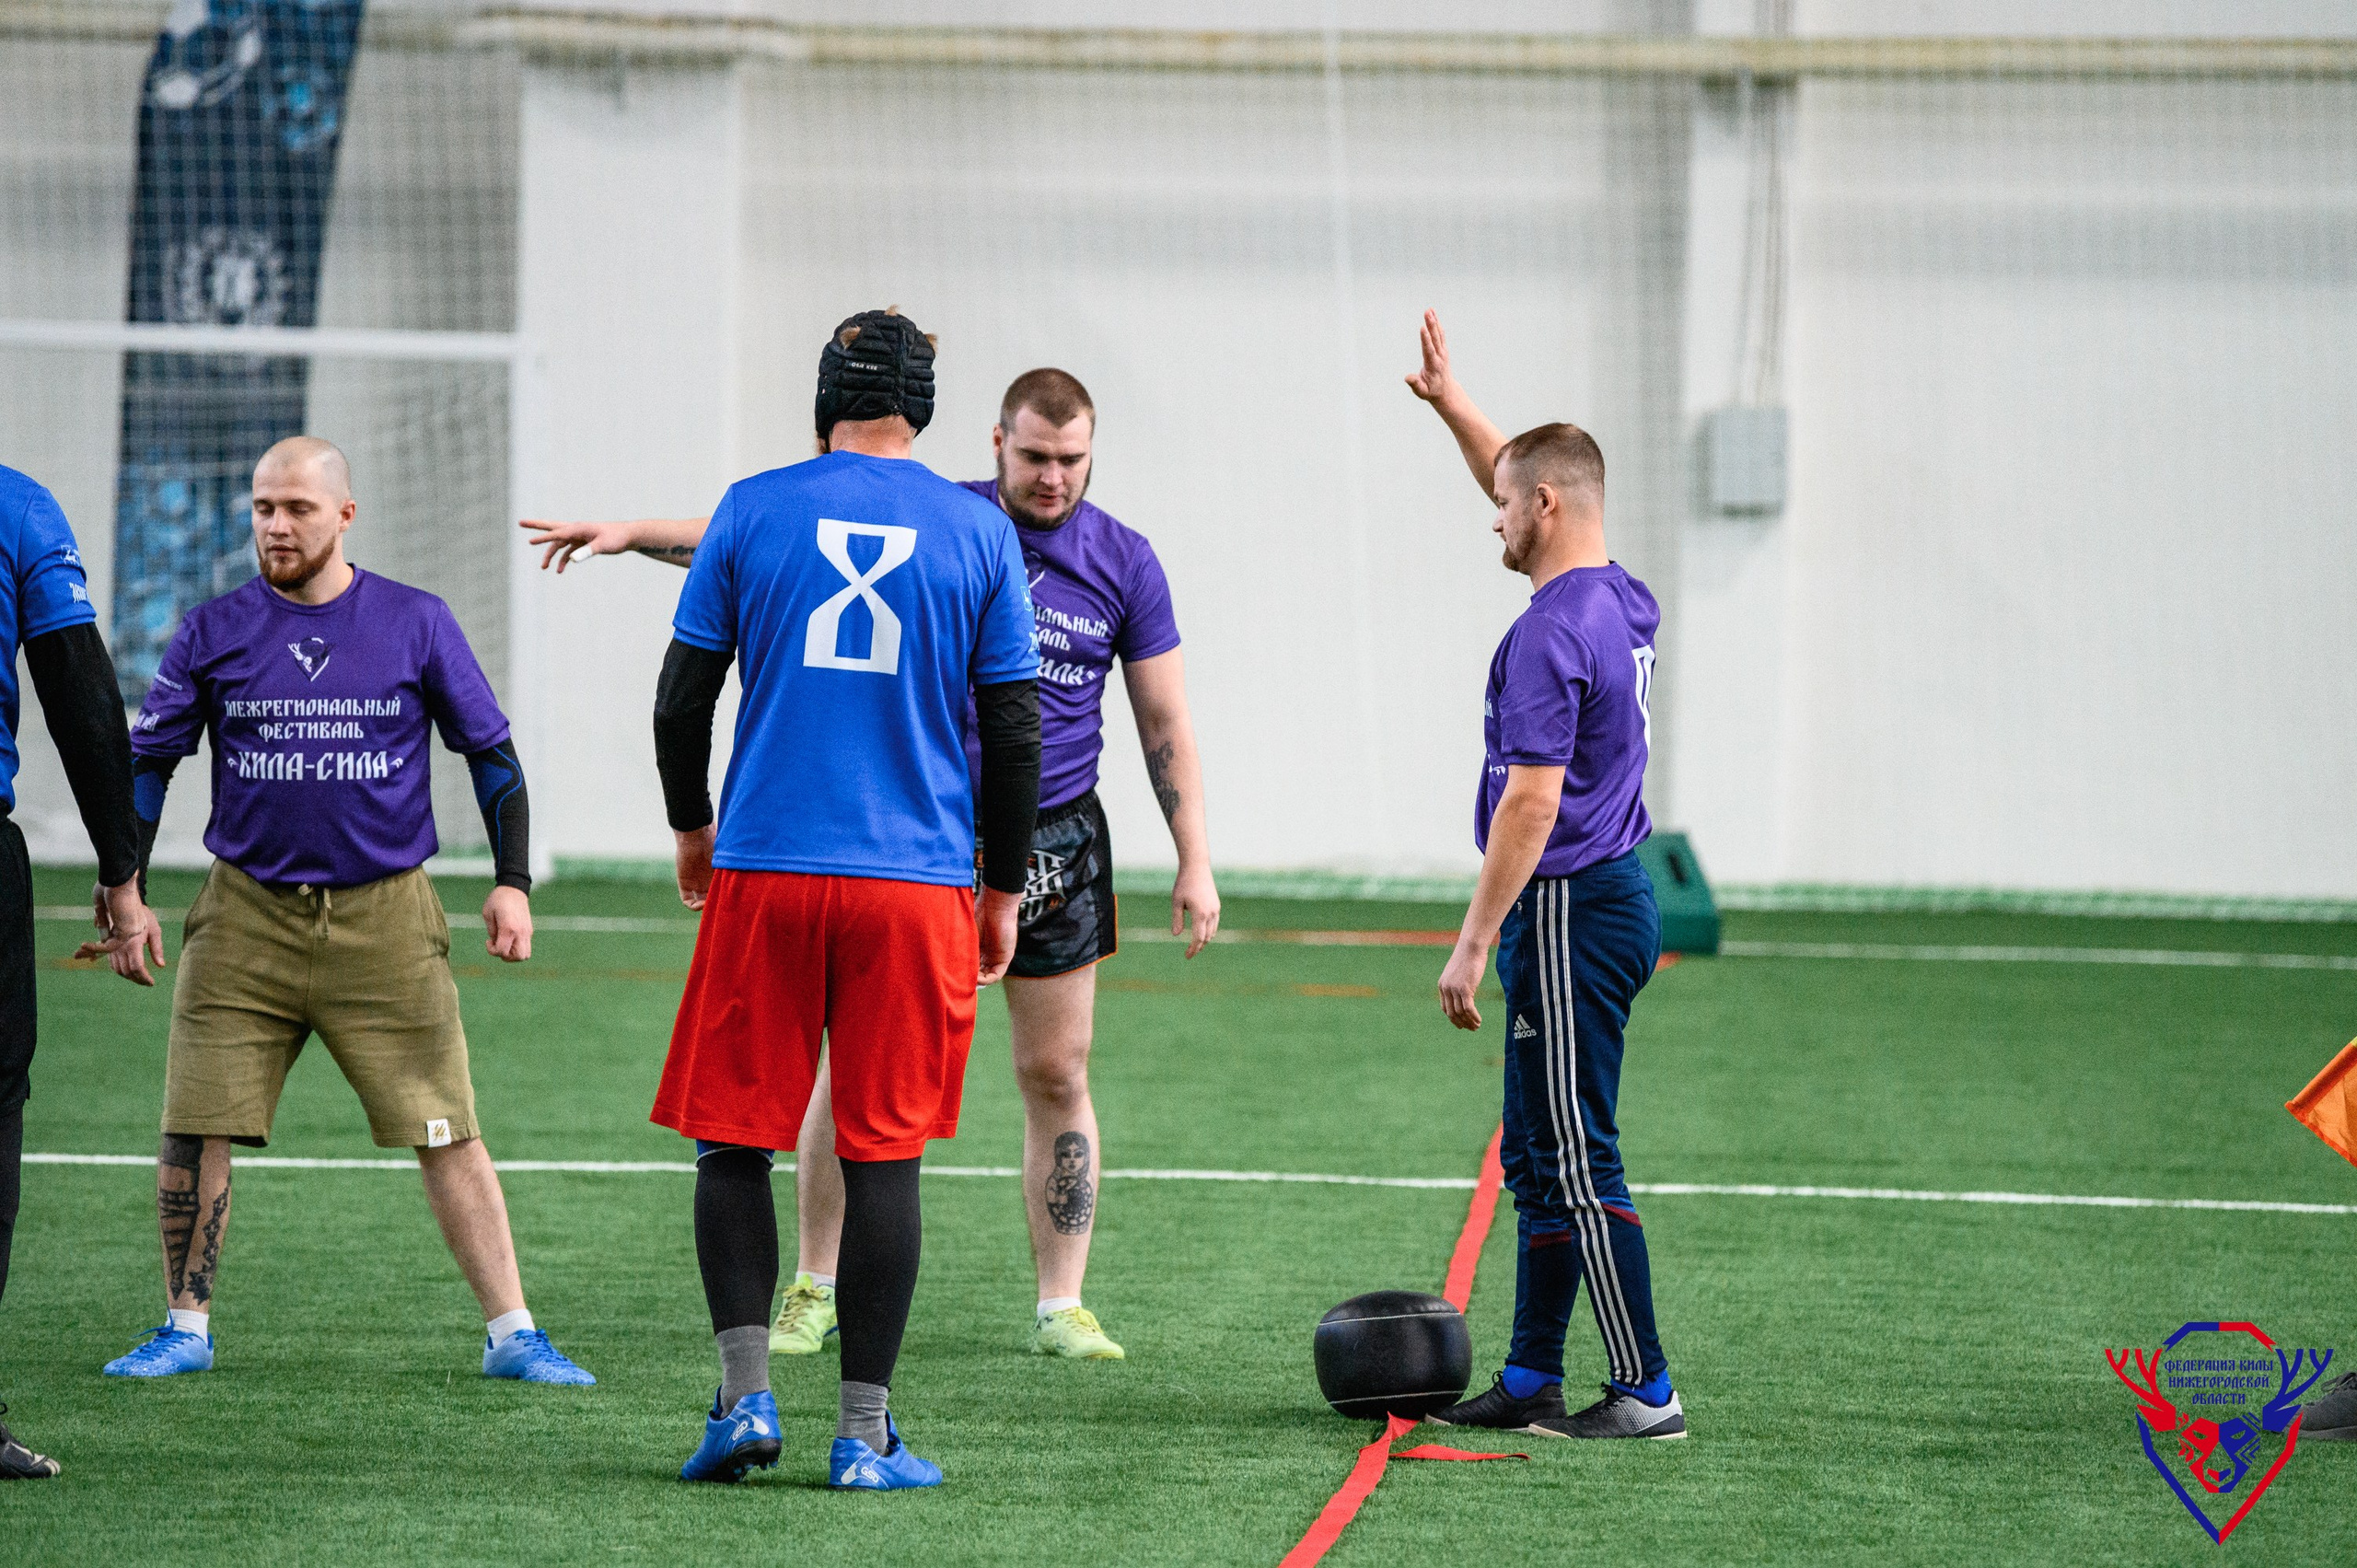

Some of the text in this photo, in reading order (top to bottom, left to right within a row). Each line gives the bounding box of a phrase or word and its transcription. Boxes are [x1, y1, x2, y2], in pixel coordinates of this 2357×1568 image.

[803, 518, 917, 675] 8
[1036, 624, 1071, 651] АЛЬ
[1037, 656, 1084, 685] ИЛА
[225, 696, 401, 717] МЕЖРЕГИОНАЛЬНЫЙ
[259, 722, 365, 742] ФЕСТИВАЛЬ
[861, 1466, 879, 1483] GSD
